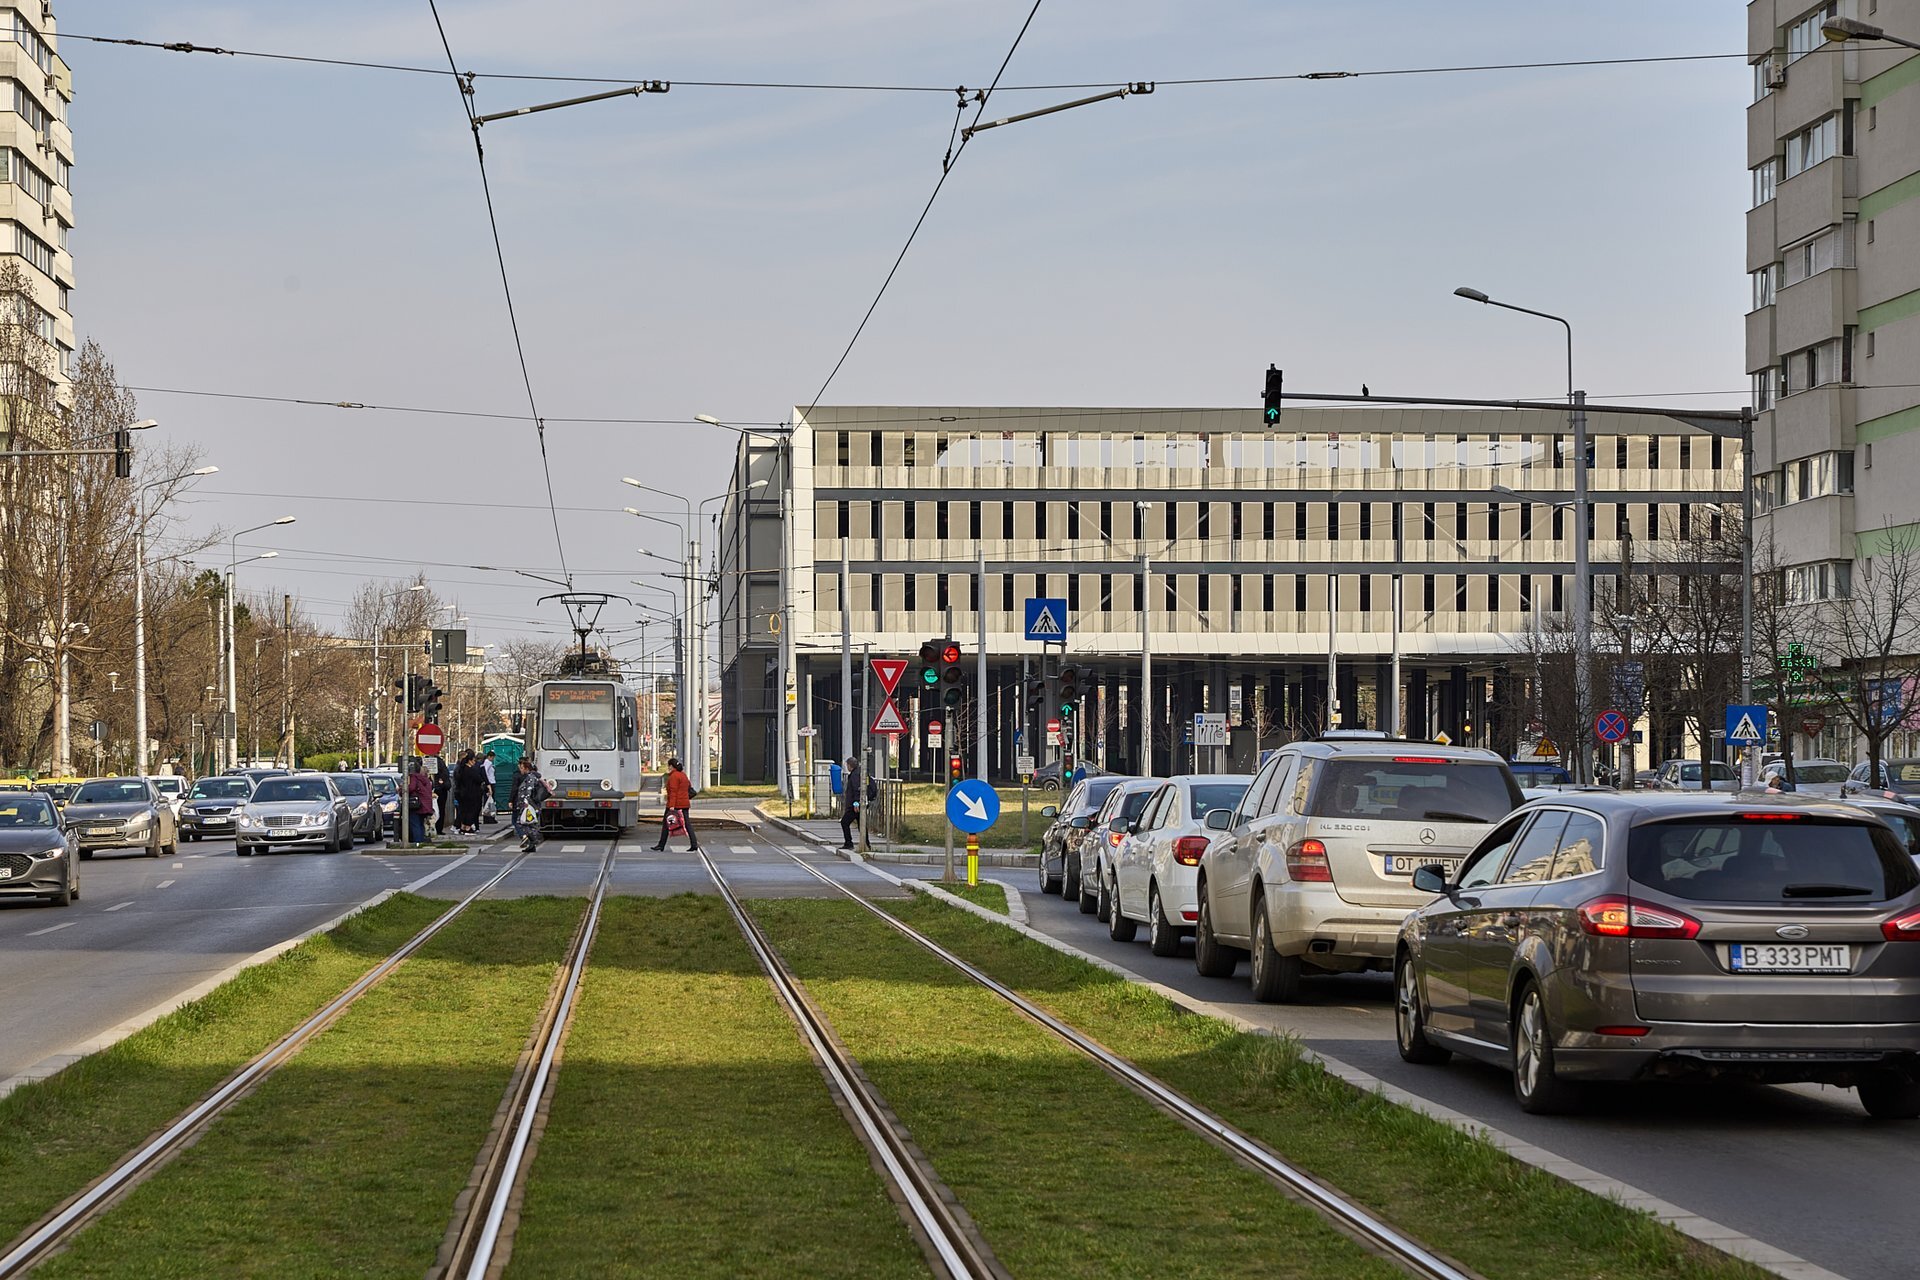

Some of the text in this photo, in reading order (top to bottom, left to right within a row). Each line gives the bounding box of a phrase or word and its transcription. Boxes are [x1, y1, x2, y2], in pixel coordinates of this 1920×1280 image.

[549, 690, 560, 700] 55
[565, 764, 590, 772] 4042
[1396, 857, 1413, 871] OT
[1744, 947, 1844, 966] B 333 PMT
